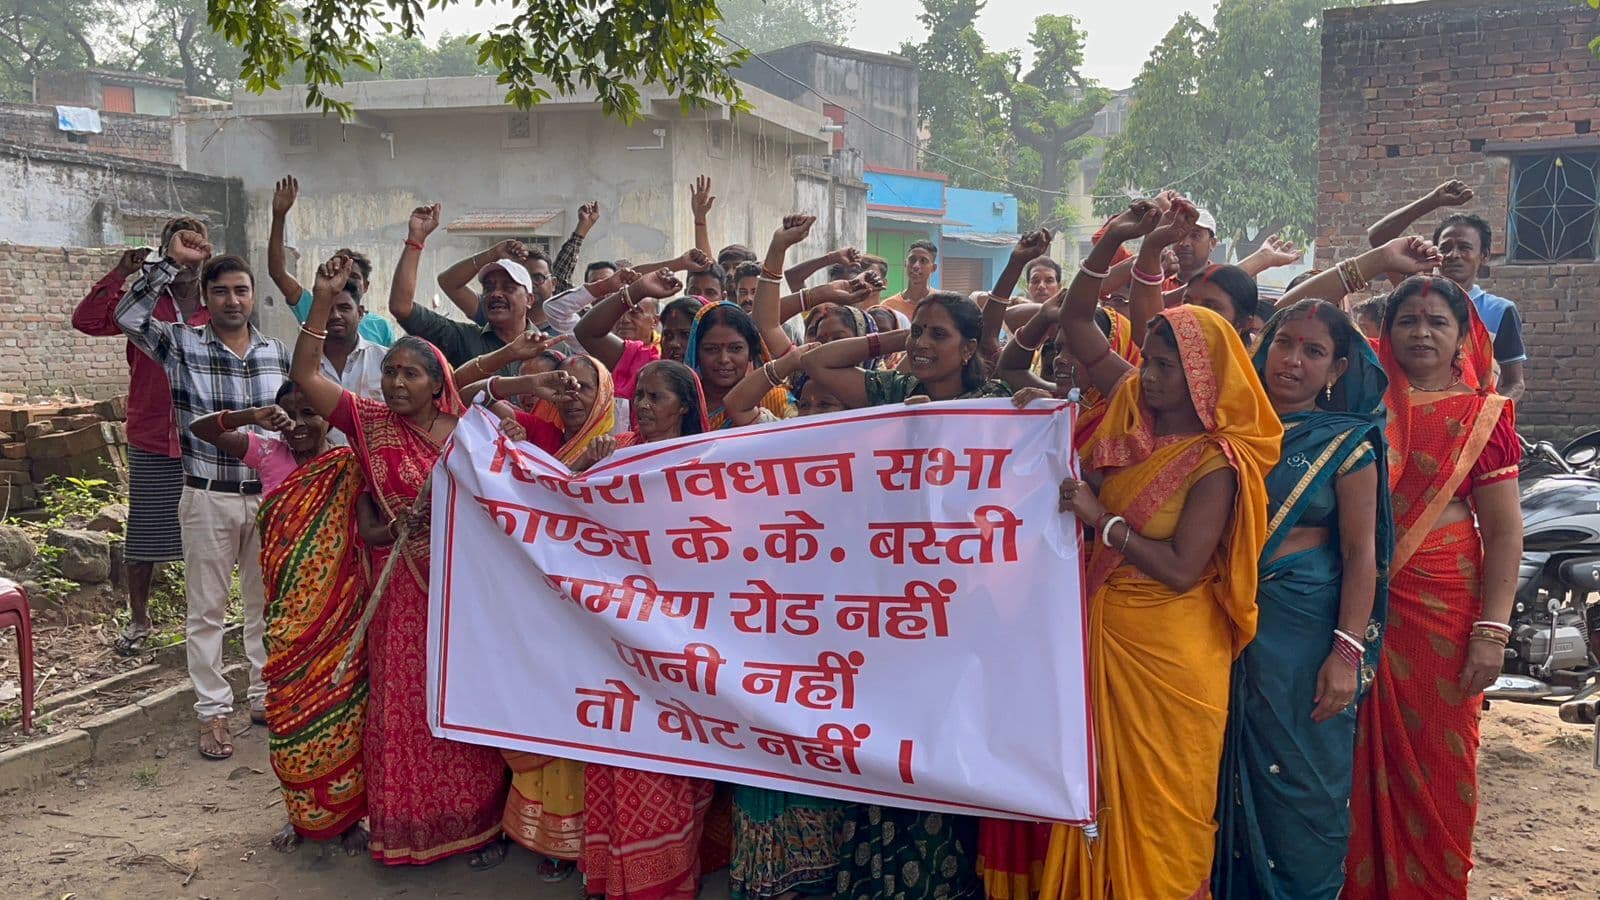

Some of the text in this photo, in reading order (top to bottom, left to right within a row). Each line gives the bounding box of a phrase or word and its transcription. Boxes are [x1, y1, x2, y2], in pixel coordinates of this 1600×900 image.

[661, 451, 856, 502] विधान
[873, 447, 1013, 491] सभा
[868, 505, 1023, 564] बस्ती
[729, 580, 824, 635] रोड
[835, 578, 957, 639] नहीं
[611, 637, 865, 710] पानी नहीं
[575, 678, 640, 732] तो
[655, 697, 746, 750] वोट
[750, 723, 871, 775] नहीं
